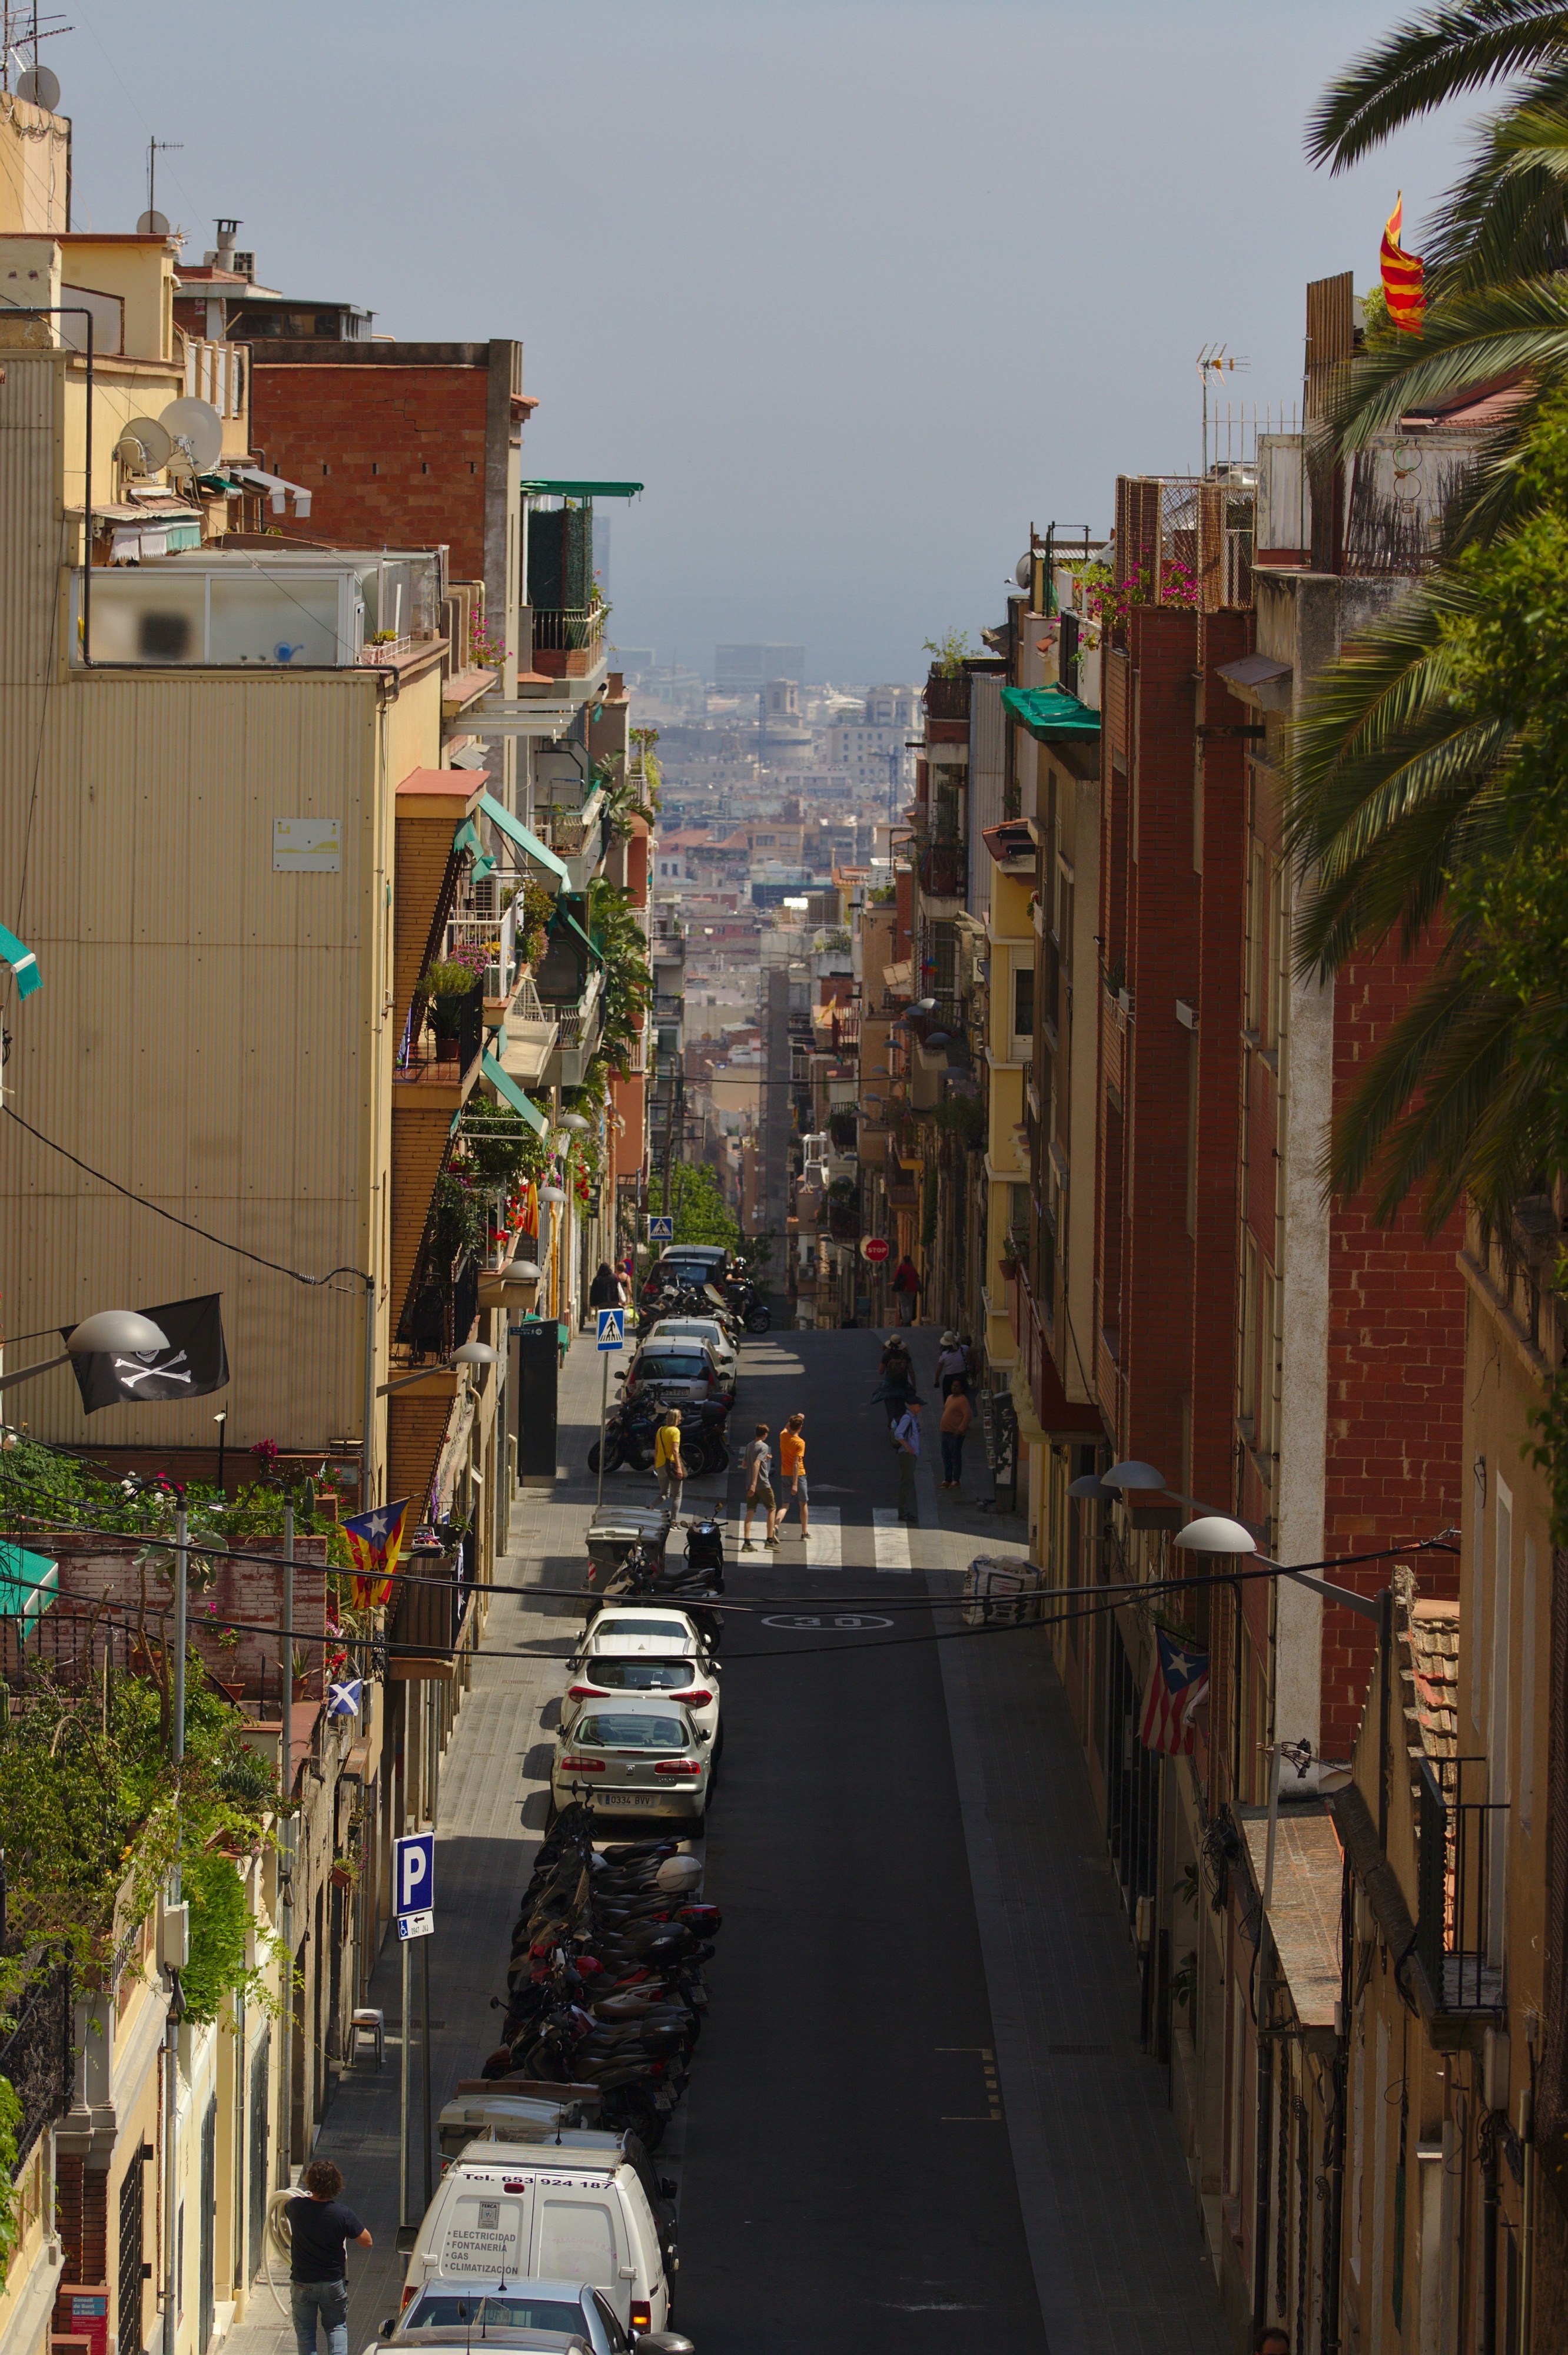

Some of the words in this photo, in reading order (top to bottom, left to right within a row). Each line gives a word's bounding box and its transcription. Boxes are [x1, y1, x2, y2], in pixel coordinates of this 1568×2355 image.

[794, 1617, 861, 1627] 30
[404, 1846, 426, 1906] P
[463, 2174, 495, 2182] Tel.
[502, 2176, 534, 2184] 653
[541, 2178, 573, 2187] 924
[580, 2181, 614, 2190] 187
[453, 2230, 516, 2242] ELECTRICIDAD
[452, 2240, 507, 2253] FONTANERÍA
[451, 2251, 469, 2261] GAS
[450, 2263, 518, 2275] CLIMATIZACIÓN
